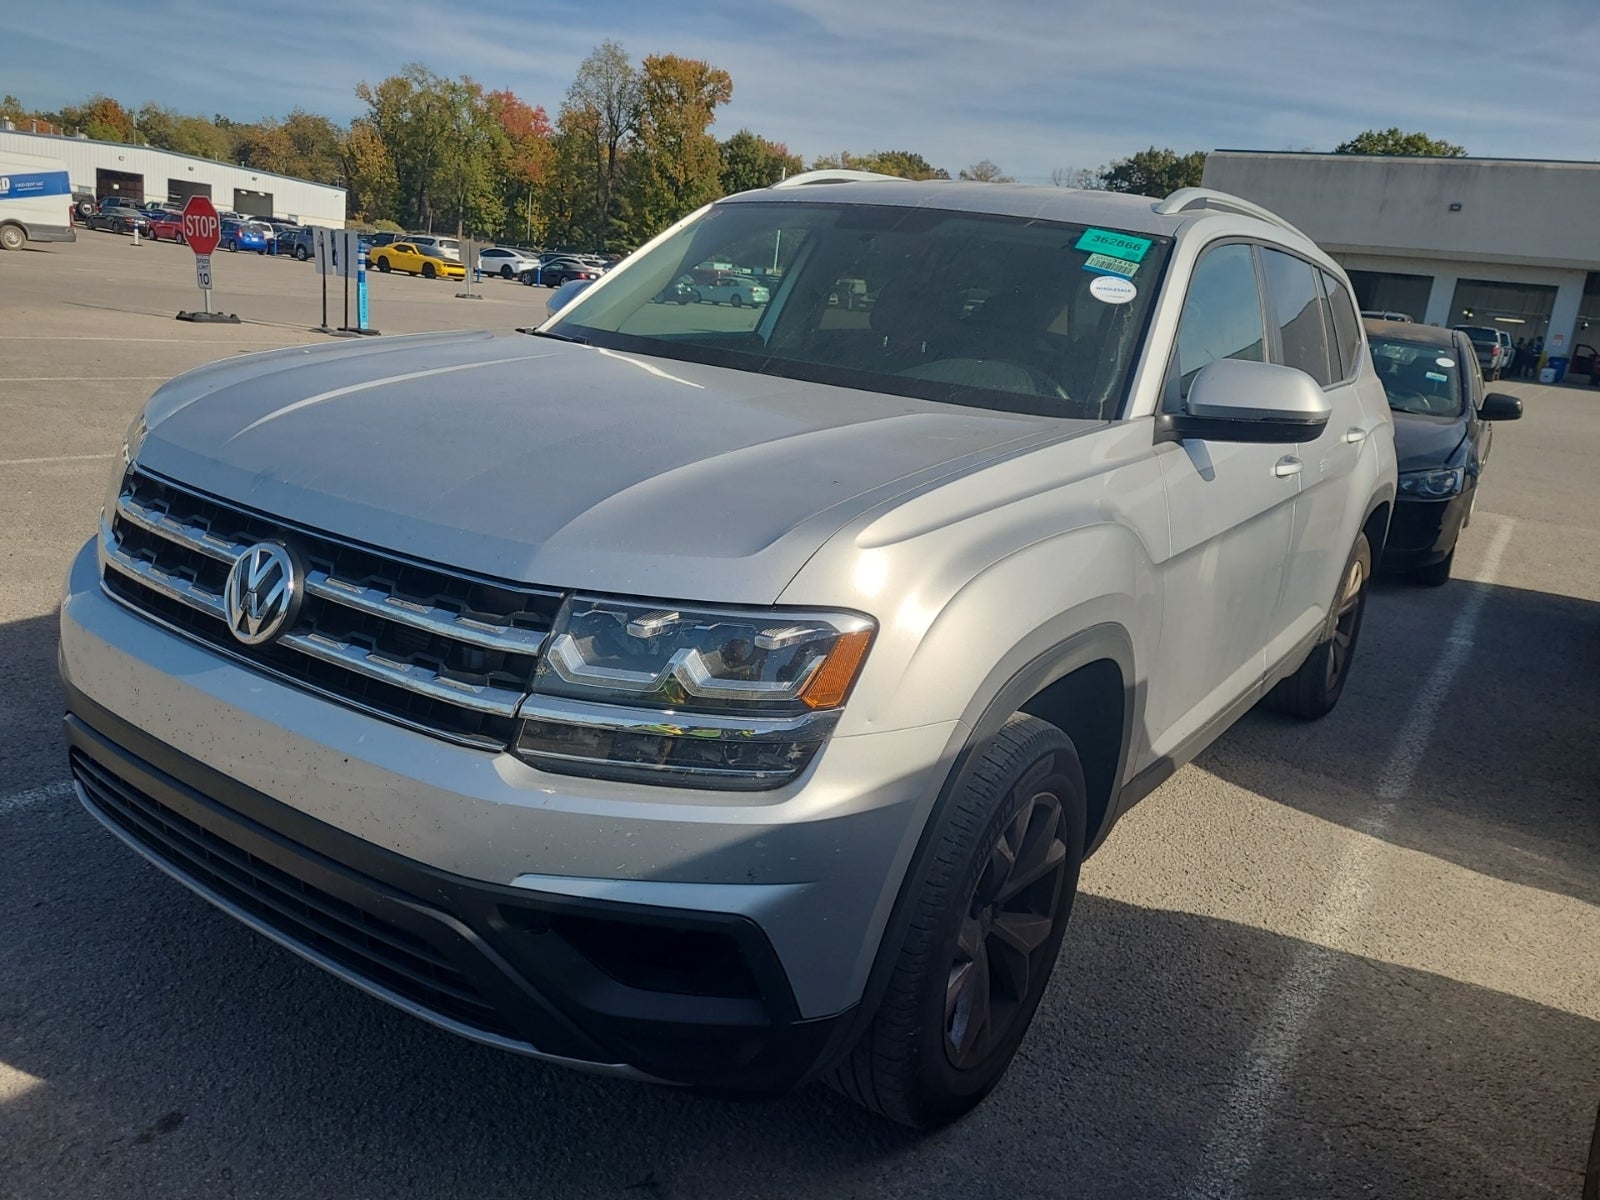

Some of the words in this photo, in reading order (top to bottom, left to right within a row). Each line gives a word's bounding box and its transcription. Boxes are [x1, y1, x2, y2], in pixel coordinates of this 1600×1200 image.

[186, 214, 217, 238] STOP
[1091, 234, 1143, 251] 362866
[199, 272, 210, 285] 10
